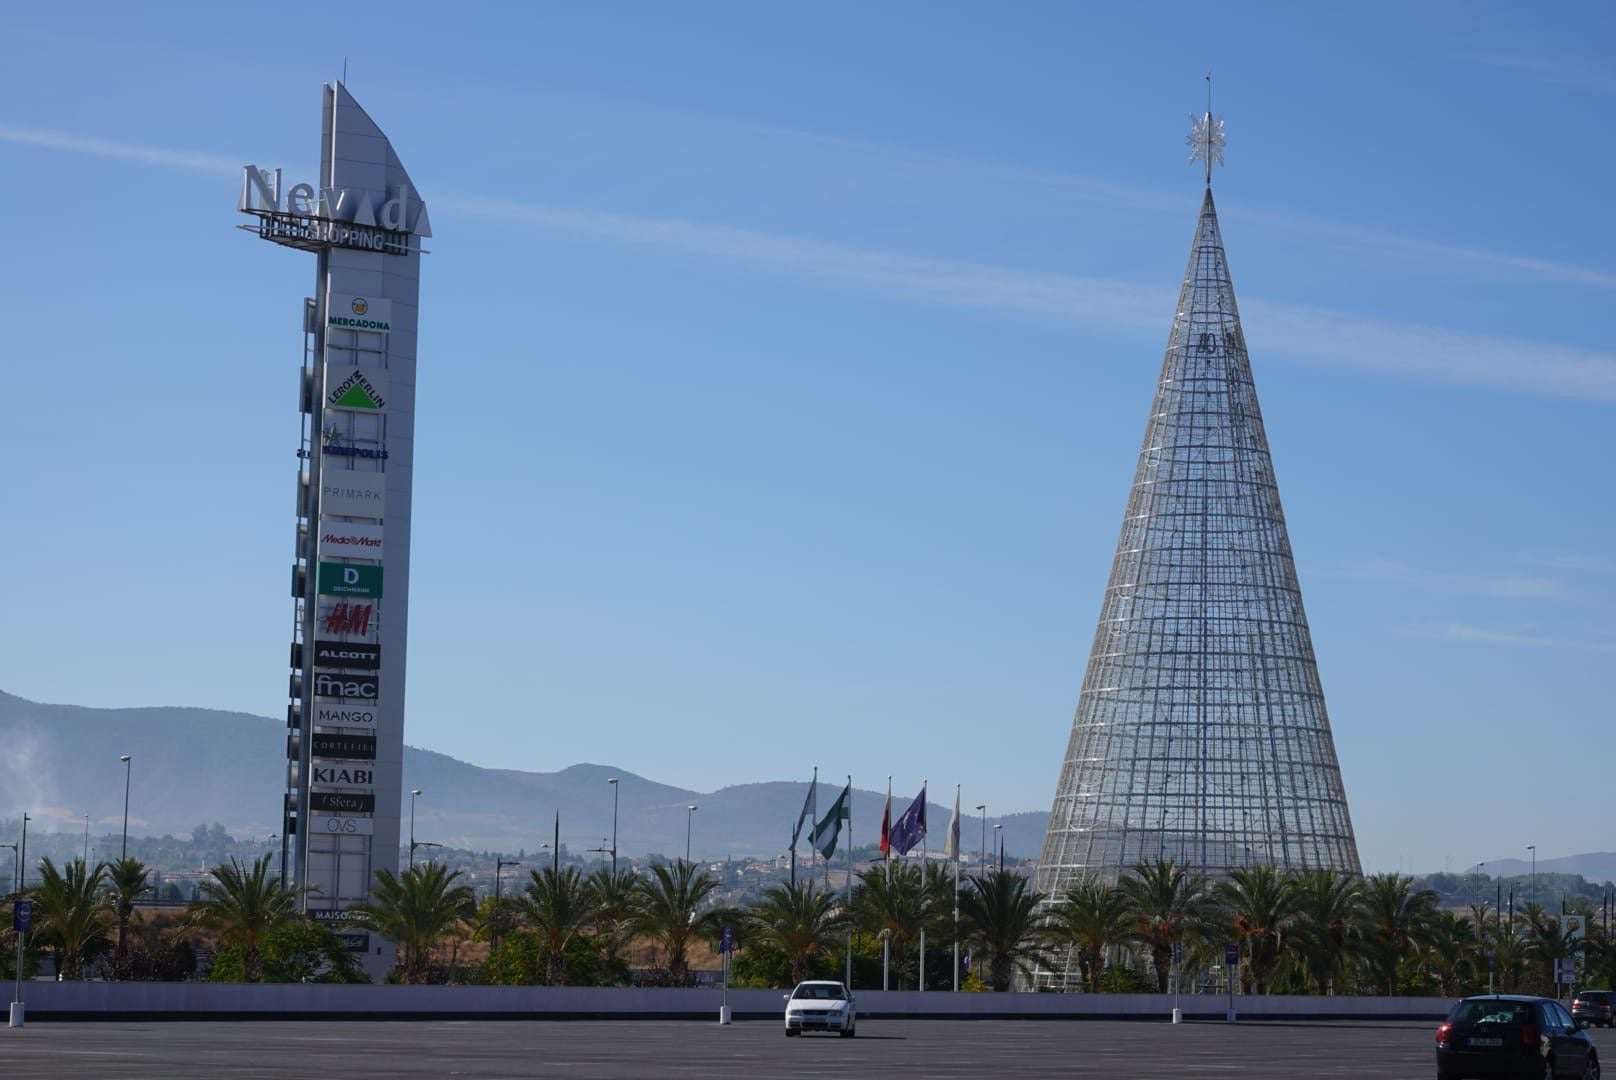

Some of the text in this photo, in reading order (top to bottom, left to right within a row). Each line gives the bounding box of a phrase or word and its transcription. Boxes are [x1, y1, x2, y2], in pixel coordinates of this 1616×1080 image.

[328, 315, 390, 331] MERCADONA
[327, 369, 386, 409] LEROY MERLIN
[324, 486, 381, 500] PRIMARK
[343, 567, 359, 585] D
[333, 585, 371, 593] DEICHMANN
[326, 602, 372, 636] H&M
[319, 649, 377, 660] ALCOTT
[316, 675, 377, 698] fnac
[319, 709, 373, 723] MANGO
[313, 740, 375, 753] CORTEFIEL
[314, 767, 373, 785] KIABI
[327, 818, 356, 833] OVS
